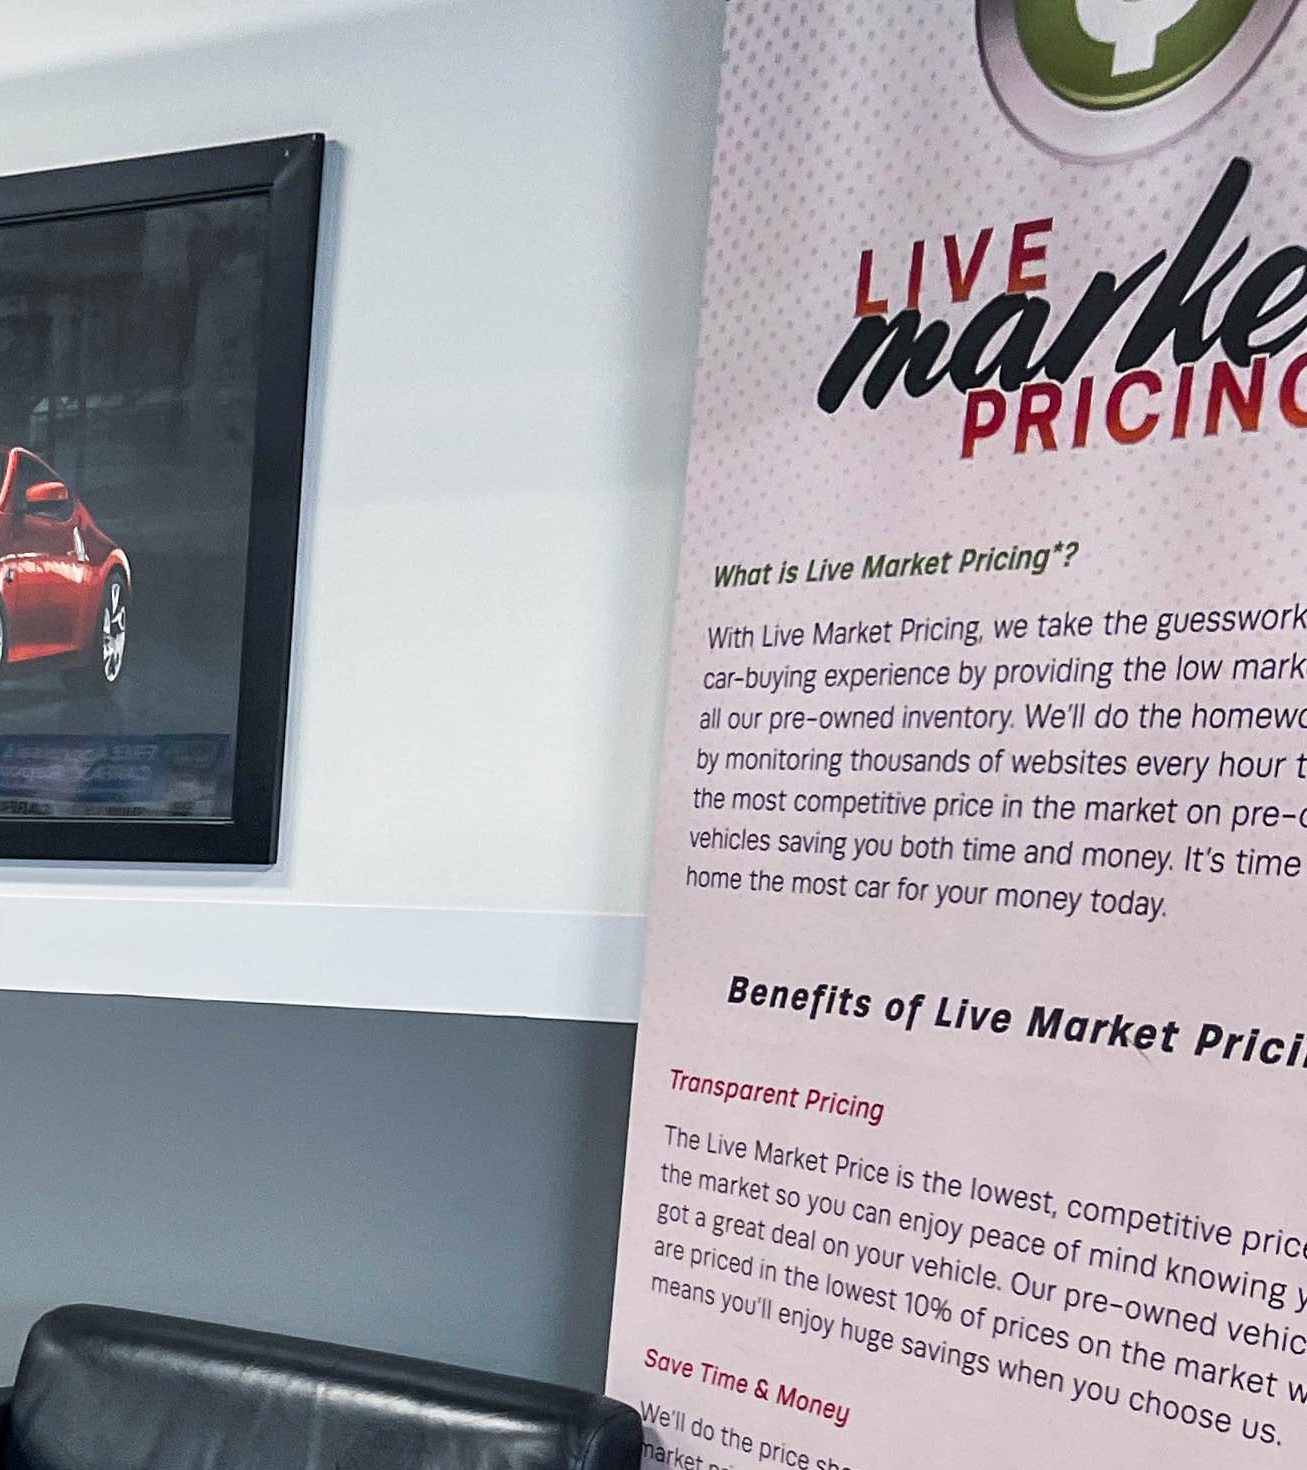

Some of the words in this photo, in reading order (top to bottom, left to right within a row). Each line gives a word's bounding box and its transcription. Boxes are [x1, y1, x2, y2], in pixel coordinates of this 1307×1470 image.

[854, 217, 1054, 317] LIVE
[714, 563, 773, 588] What
[778, 561, 798, 584] is
[806, 559, 854, 582] Live
[861, 551, 952, 579] Market
[708, 625, 753, 648] With
[762, 624, 804, 647] Live
[813, 620, 892, 645] Market
[900, 617, 984, 647] Pricing,
[994, 619, 1028, 638] we
[1038, 611, 1092, 638] take
[1104, 610, 1147, 635] the
[1156, 602, 1307, 641] guesswork
[703, 666, 816, 693] car-buying
[825, 662, 950, 691] experience
[959, 660, 986, 691] by
[993, 658, 1113, 689] providing
[1123, 656, 1166, 682] the
[1176, 655, 1222, 680] low
[697, 748, 719, 775] by
[726, 748, 842, 777] monitoring
[850, 749, 969, 773] thousands
[978, 748, 1005, 773] of
[1011, 748, 1127, 774] websites
[1136, 754, 1209, 783] every
[1218, 751, 1286, 778] hour
[693, 788, 725, 809] the
[732, 790, 786, 812] most
[794, 791, 926, 818] competitive
[934, 792, 994, 821] price
[1001, 794, 1022, 819] in
[1032, 795, 1075, 820] the
[1085, 797, 1178, 823] market
[1186, 803, 1221, 825] on
[686, 866, 742, 889] home
[749, 870, 784, 892] the
[792, 875, 847, 896] most
[855, 880, 890, 898] car
[897, 877, 929, 901] for
[934, 885, 988, 908] your
[996, 888, 1082, 917] money
[1090, 889, 1166, 922] today.
[727, 976, 872, 1020] Benefits
[884, 994, 925, 1031] of
[933, 996, 1012, 1033] Live
[1026, 1006, 1179, 1053] Market
[1194, 1023, 1307, 1068] Prici
[670, 1069, 800, 1108] Transparent
[804, 1089, 884, 1126] Pricing
[665, 1124, 700, 1150] The
[707, 1132, 747, 1159] Live
[754, 1139, 829, 1174] Market
[835, 1154, 888, 1184] Price
[895, 1165, 914, 1189] is
[921, 1170, 962, 1197] the
[970, 1177, 1058, 1219] lowest,
[1067, 1199, 1232, 1246] competitive
[657, 1202, 690, 1225] got
[695, 1211, 706, 1227] a
[712, 1214, 765, 1236] great
[771, 1224, 815, 1250] deal
[823, 1237, 849, 1258] on
[855, 1244, 905, 1269] your
[911, 1255, 1001, 1291] vehicle.
[1011, 1272, 1056, 1301] Our
[1064, 1286, 1217, 1336] pre-owned
[661, 1162, 692, 1187] the
[699, 1172, 770, 1202] market
[775, 1188, 801, 1208] so
[807, 1194, 845, 1216] you
[852, 1202, 891, 1226] can
[899, 1212, 962, 1244] enjoy
[969, 1224, 1045, 1255] peace
[1054, 1240, 1082, 1262] of
[1089, 1247, 1157, 1278] mind
[1165, 1257, 1287, 1309] knowing
[644, 1349, 693, 1377] Save
[701, 1362, 747, 1393] Time
[754, 1379, 769, 1400] &
[776, 1385, 850, 1428] Money
[651, 1275, 715, 1305] means
[720, 1292, 771, 1320] you'll
[779, 1306, 834, 1339] enjoy
[841, 1318, 893, 1351] huge
[901, 1337, 990, 1375] savings
[998, 1359, 1064, 1392] when
[1070, 1378, 1119, 1405] you
[1129, 1390, 1231, 1432] choose
[1242, 1418, 1282, 1446] us.
[641, 1400, 685, 1432] We'll
[691, 1418, 714, 1440] do
[721, 1426, 753, 1452] the
[759, 1441, 810, 1470] price
